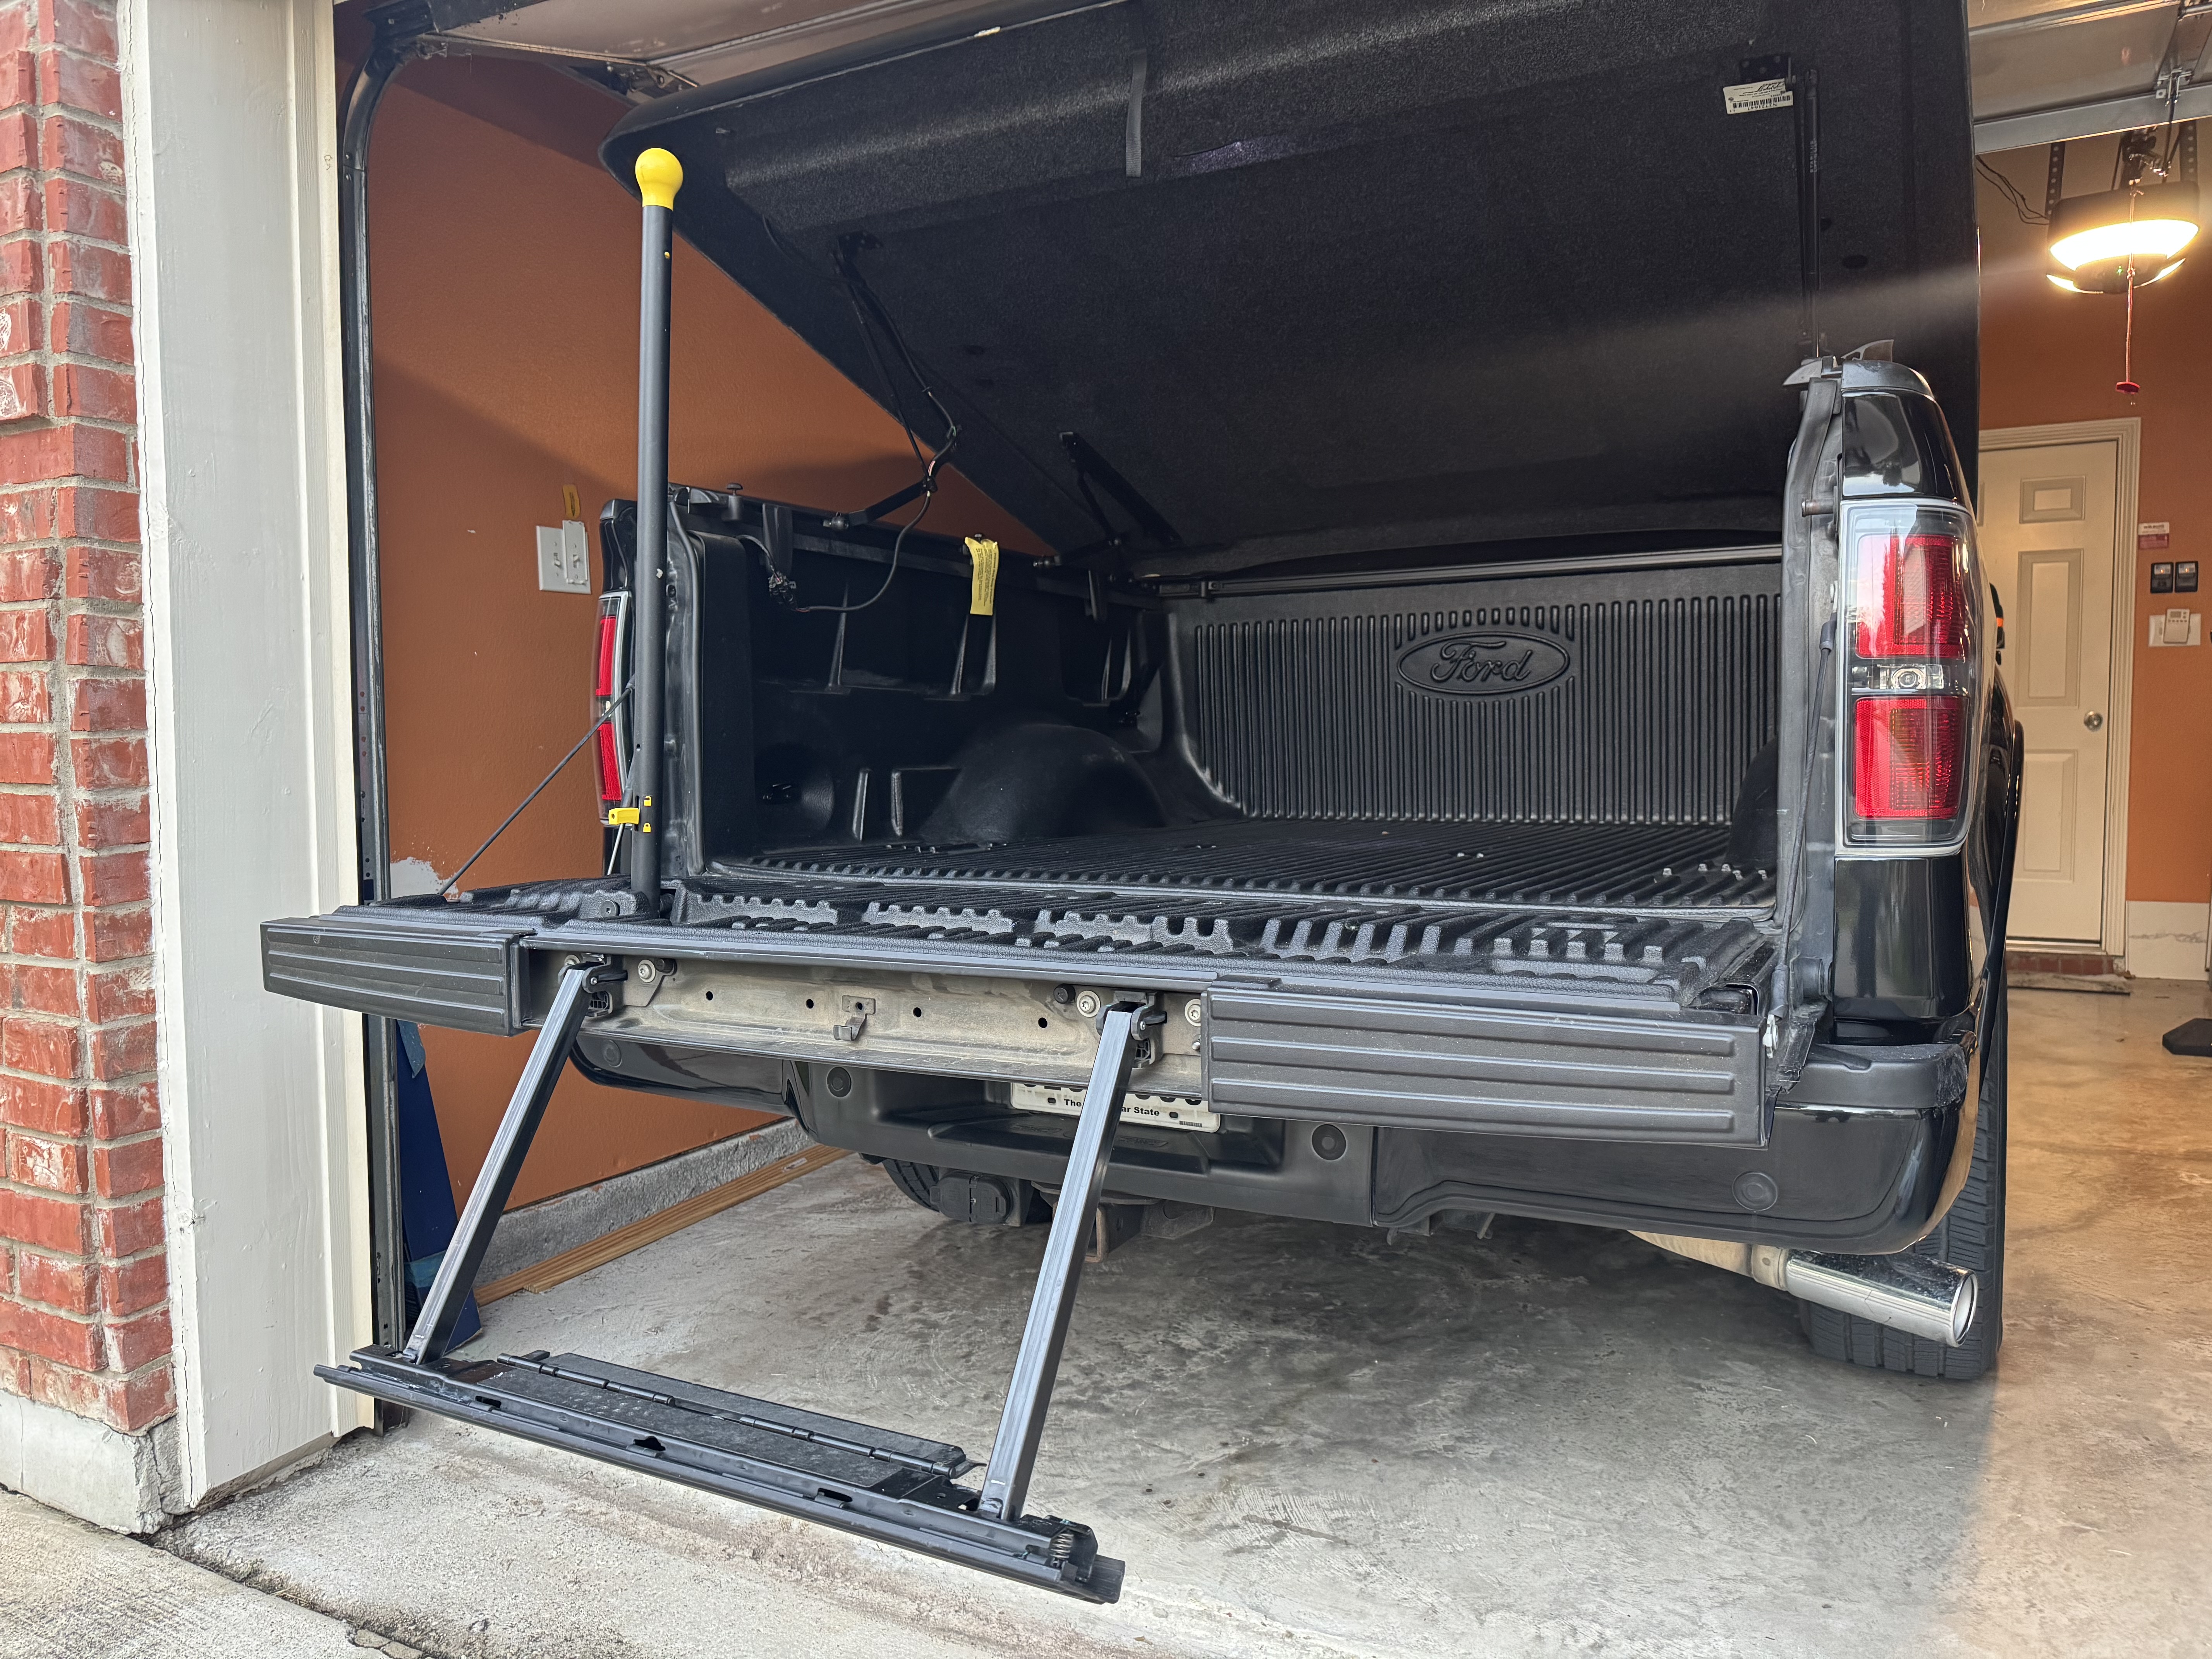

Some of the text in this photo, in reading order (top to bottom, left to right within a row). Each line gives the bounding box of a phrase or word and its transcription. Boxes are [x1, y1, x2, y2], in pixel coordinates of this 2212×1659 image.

[1431, 641, 1533, 682] Ford
[1064, 1099, 1082, 1107] The
[1134, 1106, 1160, 1116] State
